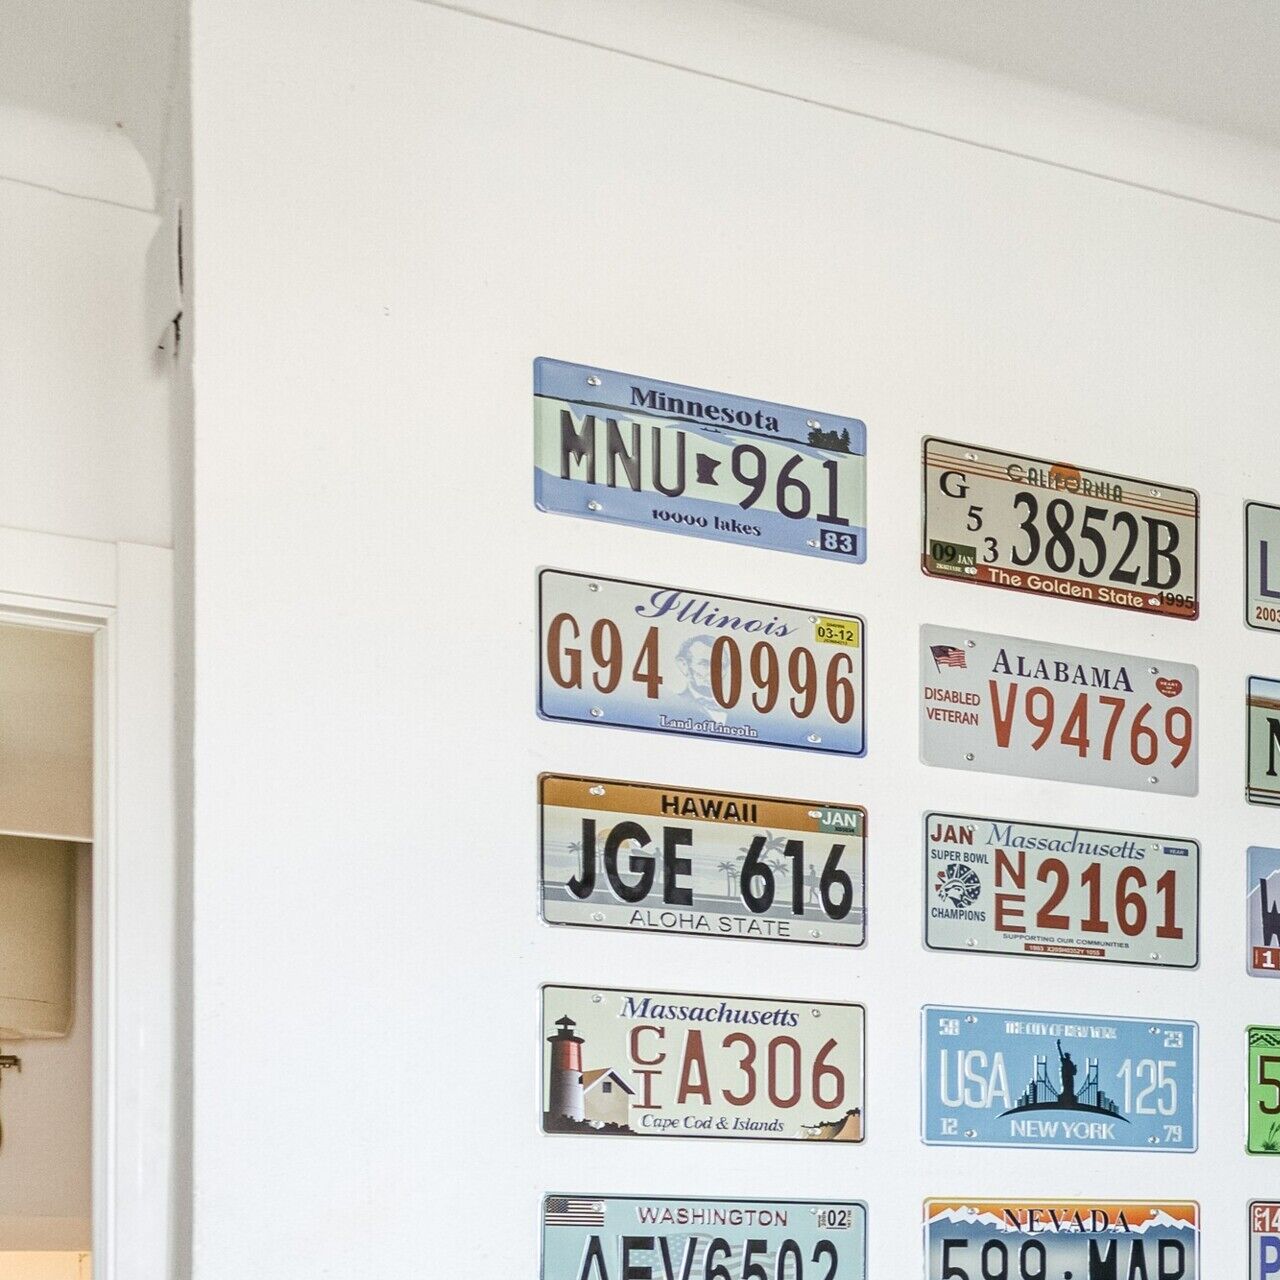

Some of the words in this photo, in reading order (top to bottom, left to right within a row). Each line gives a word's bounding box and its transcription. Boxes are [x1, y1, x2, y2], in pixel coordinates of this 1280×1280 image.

[630, 386, 779, 433] Minnesota
[560, 409, 685, 497] MNU
[731, 444, 850, 526] 961
[940, 472, 970, 498] G
[1006, 464, 1123, 502] CALIFORNIA
[652, 509, 707, 528] 10000
[714, 516, 761, 536] lakes
[967, 505, 983, 531] 5
[825, 532, 852, 553] 83
[983, 537, 999, 563] 3
[1011, 491, 1181, 589] 3852B
[932, 542, 957, 561] 09
[957, 554, 974, 565] JAN
[988, 568, 1022, 587] The
[1027, 576, 1092, 599] Golden
[1098, 588, 1144, 608] State
[1157, 591, 1195, 609] 1995
[635, 588, 800, 638] Illinois
[817, 626, 854, 642] 03-12
[547, 612, 663, 699] G94
[710, 635, 855, 724] 0996
[992, 648, 1134, 692] ALABAMA
[925, 687, 981, 707] DISABLED
[659, 715, 692, 731] Land
[695, 719, 709, 732] of
[708, 720, 758, 737] Lincoln
[926, 707, 979, 726] VETERAN
[988, 679, 1193, 769] V94769
[661, 794, 757, 823] HAWAII
[821, 811, 857, 827] JAN
[930, 823, 974, 845] JAN
[986, 823, 1146, 860] Massachusetts
[565, 818, 693, 906] JGE
[739, 836, 854, 920] 616
[931, 849, 961, 861] SUPER
[963, 852, 989, 865] BOWL
[1036, 858, 1184, 939] 2161
[630, 910, 711, 931] ALOHA
[718, 917, 791, 937] STATE
[931, 907, 986, 922] CHAMPIONS
[1003, 933, 1055, 943] SUPPORTING
[1075, 939, 1130, 949] COMMUNITIES
[1261, 951, 1275, 968] 1
[619, 996, 800, 1027] Massachusetts
[1164, 1030, 1184, 1048] 23
[676, 1028, 846, 1110] A306
[940, 1049, 1012, 1109] USA
[1116, 1058, 1178, 1116] 125
[640, 1114, 680, 1130] Cape
[683, 1115, 712, 1130] Cod
[715, 1117, 728, 1130] &
[731, 1118, 785, 1133] Islands
[940, 1118, 958, 1136] 12
[1010, 1120, 1060, 1138] NEW
[1062, 1122, 1116, 1140] YORK
[1163, 1125, 1182, 1142] 79
[636, 1206, 788, 1227] WASHINGTON
[827, 1210, 847, 1227] 02
[1000, 1208, 1133, 1234] NEVADA
